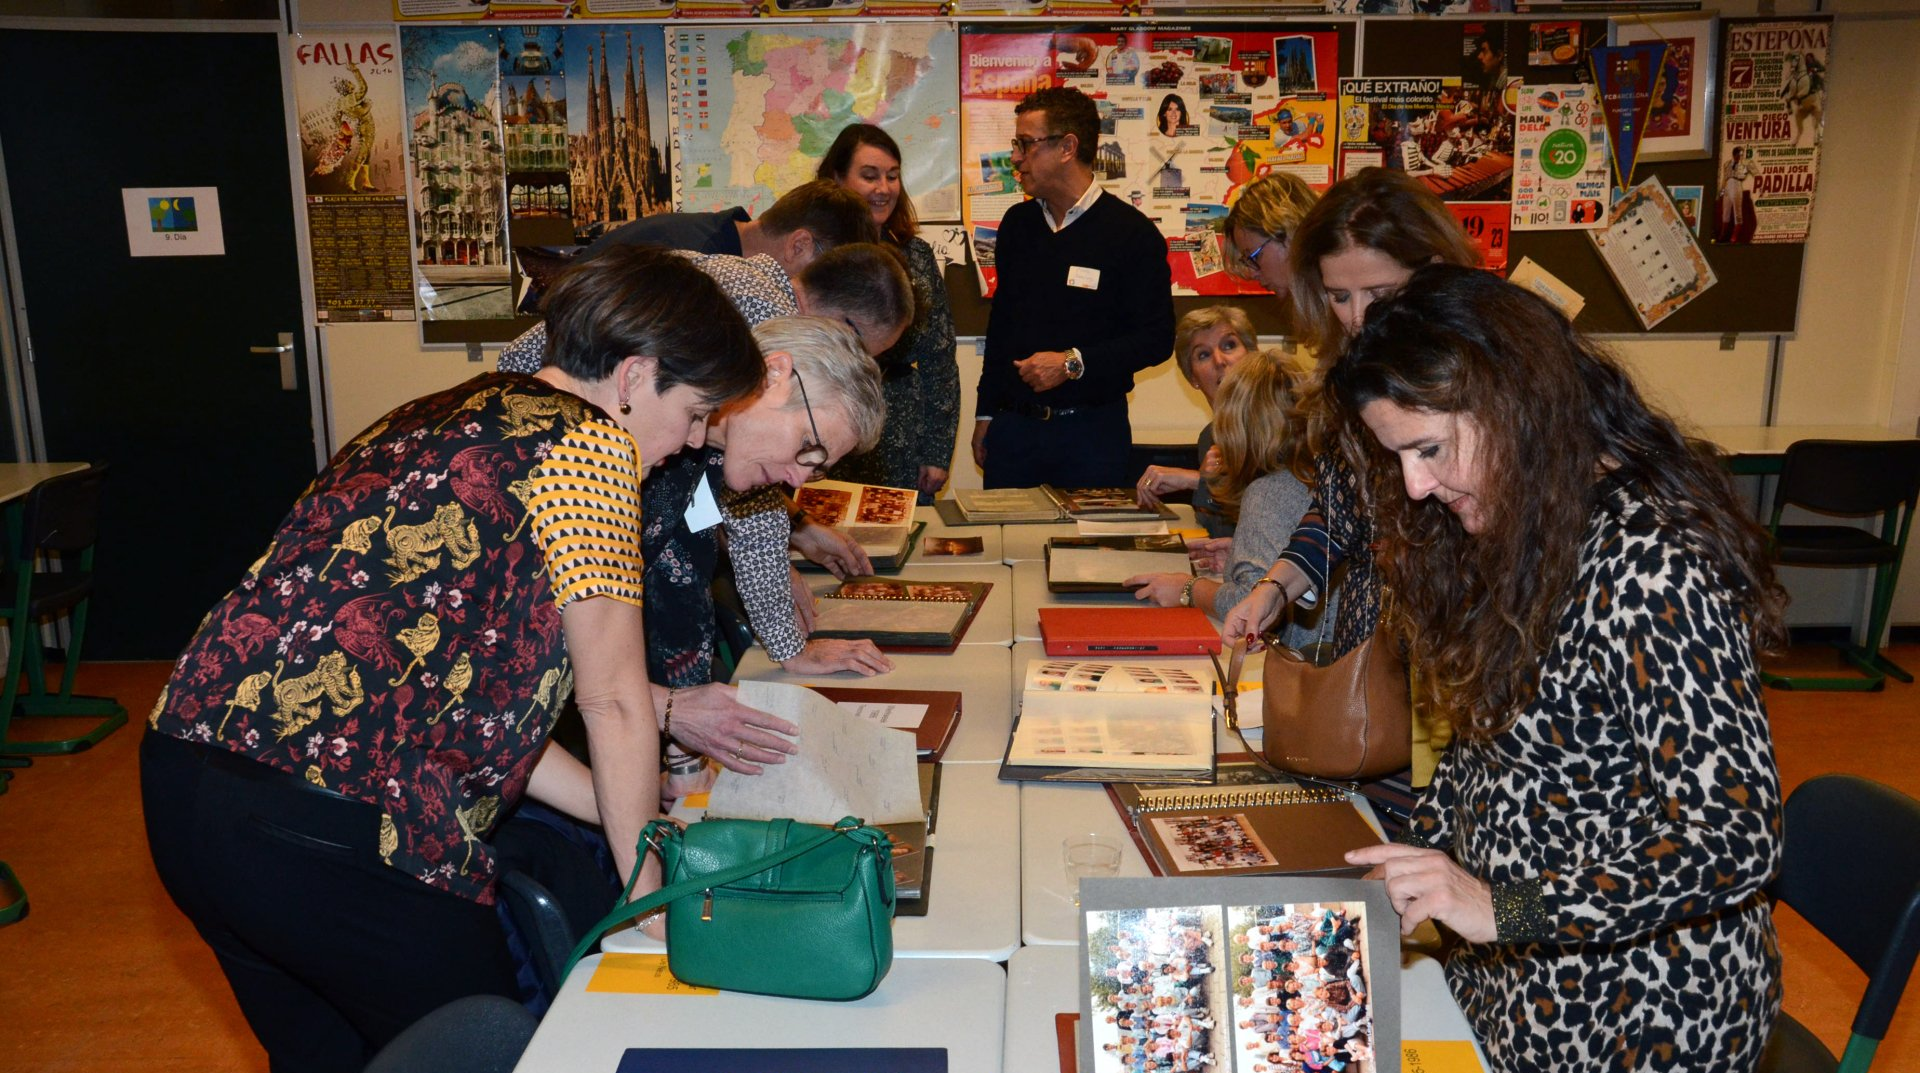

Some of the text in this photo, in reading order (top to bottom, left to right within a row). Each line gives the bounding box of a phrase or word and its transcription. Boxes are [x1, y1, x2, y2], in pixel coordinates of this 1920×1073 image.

[1730, 28, 1827, 52] ESTEPONA
[296, 42, 394, 66] FALLAS
[969, 54, 1052, 67] Bienvenido a
[969, 68, 1052, 99] España
[1732, 66, 1750, 83] 7
[1342, 78, 1440, 96] ¡QUÉ EXTRAÑO!
[1519, 115, 1544, 124] MAN
[1762, 113, 1788, 121] DIEGO
[1519, 123, 1546, 132] DELA
[1726, 121, 1791, 140] VENTURA
[672, 126, 681, 150] DE
[1762, 165, 1809, 175] JUAN JOSE
[674, 161, 684, 213] MAPA
[1752, 174, 1813, 193] PADILLA
[1462, 215, 1485, 238] 19
[1513, 212, 1549, 225] hllo!
[1491, 228, 1503, 248] 23
